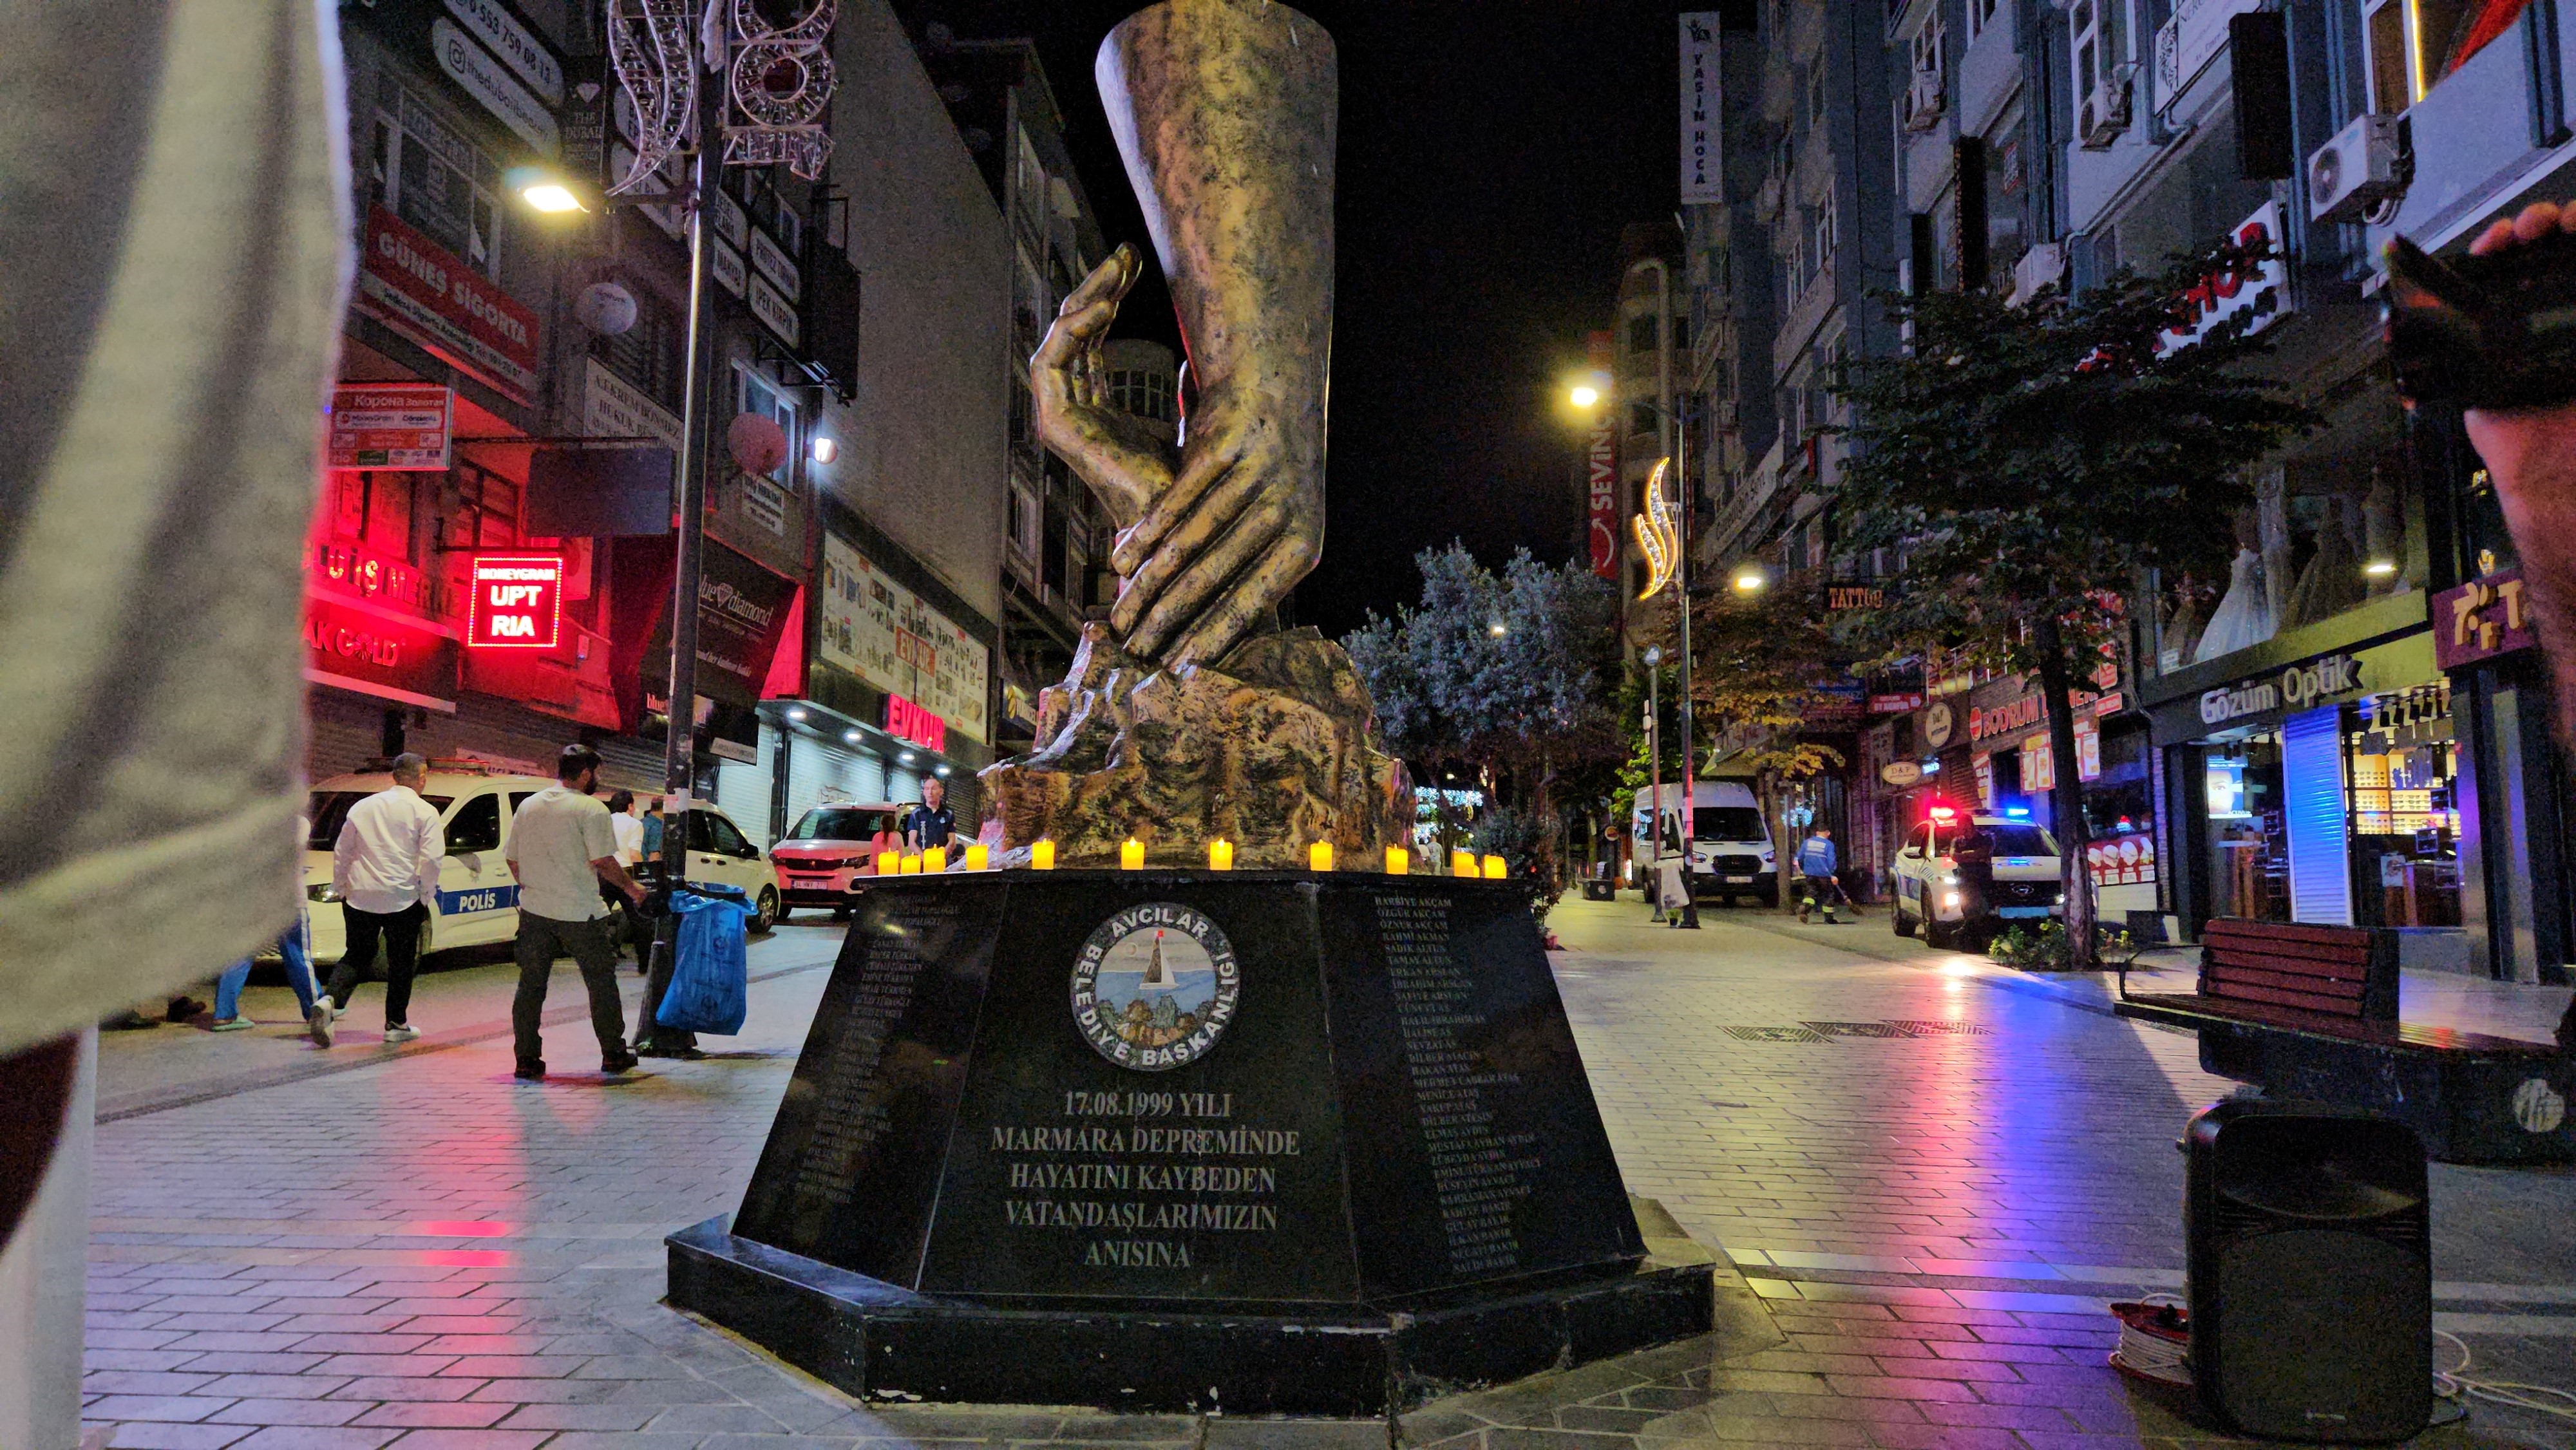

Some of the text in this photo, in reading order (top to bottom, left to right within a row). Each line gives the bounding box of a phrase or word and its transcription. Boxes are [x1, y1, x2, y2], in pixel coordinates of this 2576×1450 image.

[480, 4, 499, 34] 553
[502, 25, 522, 55] 759
[524, 47, 536, 71] 08
[540, 61, 551, 84] 13
[1694, 131, 1706, 185] HOCA
[378, 232, 448, 298] GÜNEŞ
[454, 279, 528, 348] SİGORTA
[354, 394, 404, 408] Корона
[478, 568, 556, 581] MONEYGRAM
[491, 585, 542, 607] UPT
[728, 590, 774, 628] diamond
[491, 615, 535, 636] RIA
[2201, 654, 2355, 724] Gözüm Optik
[888, 693, 945, 755] EVKUR
[1983, 696, 2039, 738] BODRUM
[458, 891, 496, 912] POLİS
[1374, 894, 1452, 909] HARBİYE AKÇAM
[1376, 907, 1446, 919] ÖZGÜR AKÇAM
[1111, 907, 1209, 939] AVCILAR
[1414, 920, 1448, 931] AKÇAM
[1384, 943, 1414, 952] SADIK
[1065, 1091, 1231, 1117] 17.08.1999 YILI
[991, 1124, 1300, 1156] MARMARA DEPREMİNDE
[1010, 1163, 1276, 1192] HAYATINI KAYBEDEN
[1005, 1201, 1278, 1232] VATANDAŞLARIMIZIN
[1084, 1241, 1191, 1268] ANISINA
